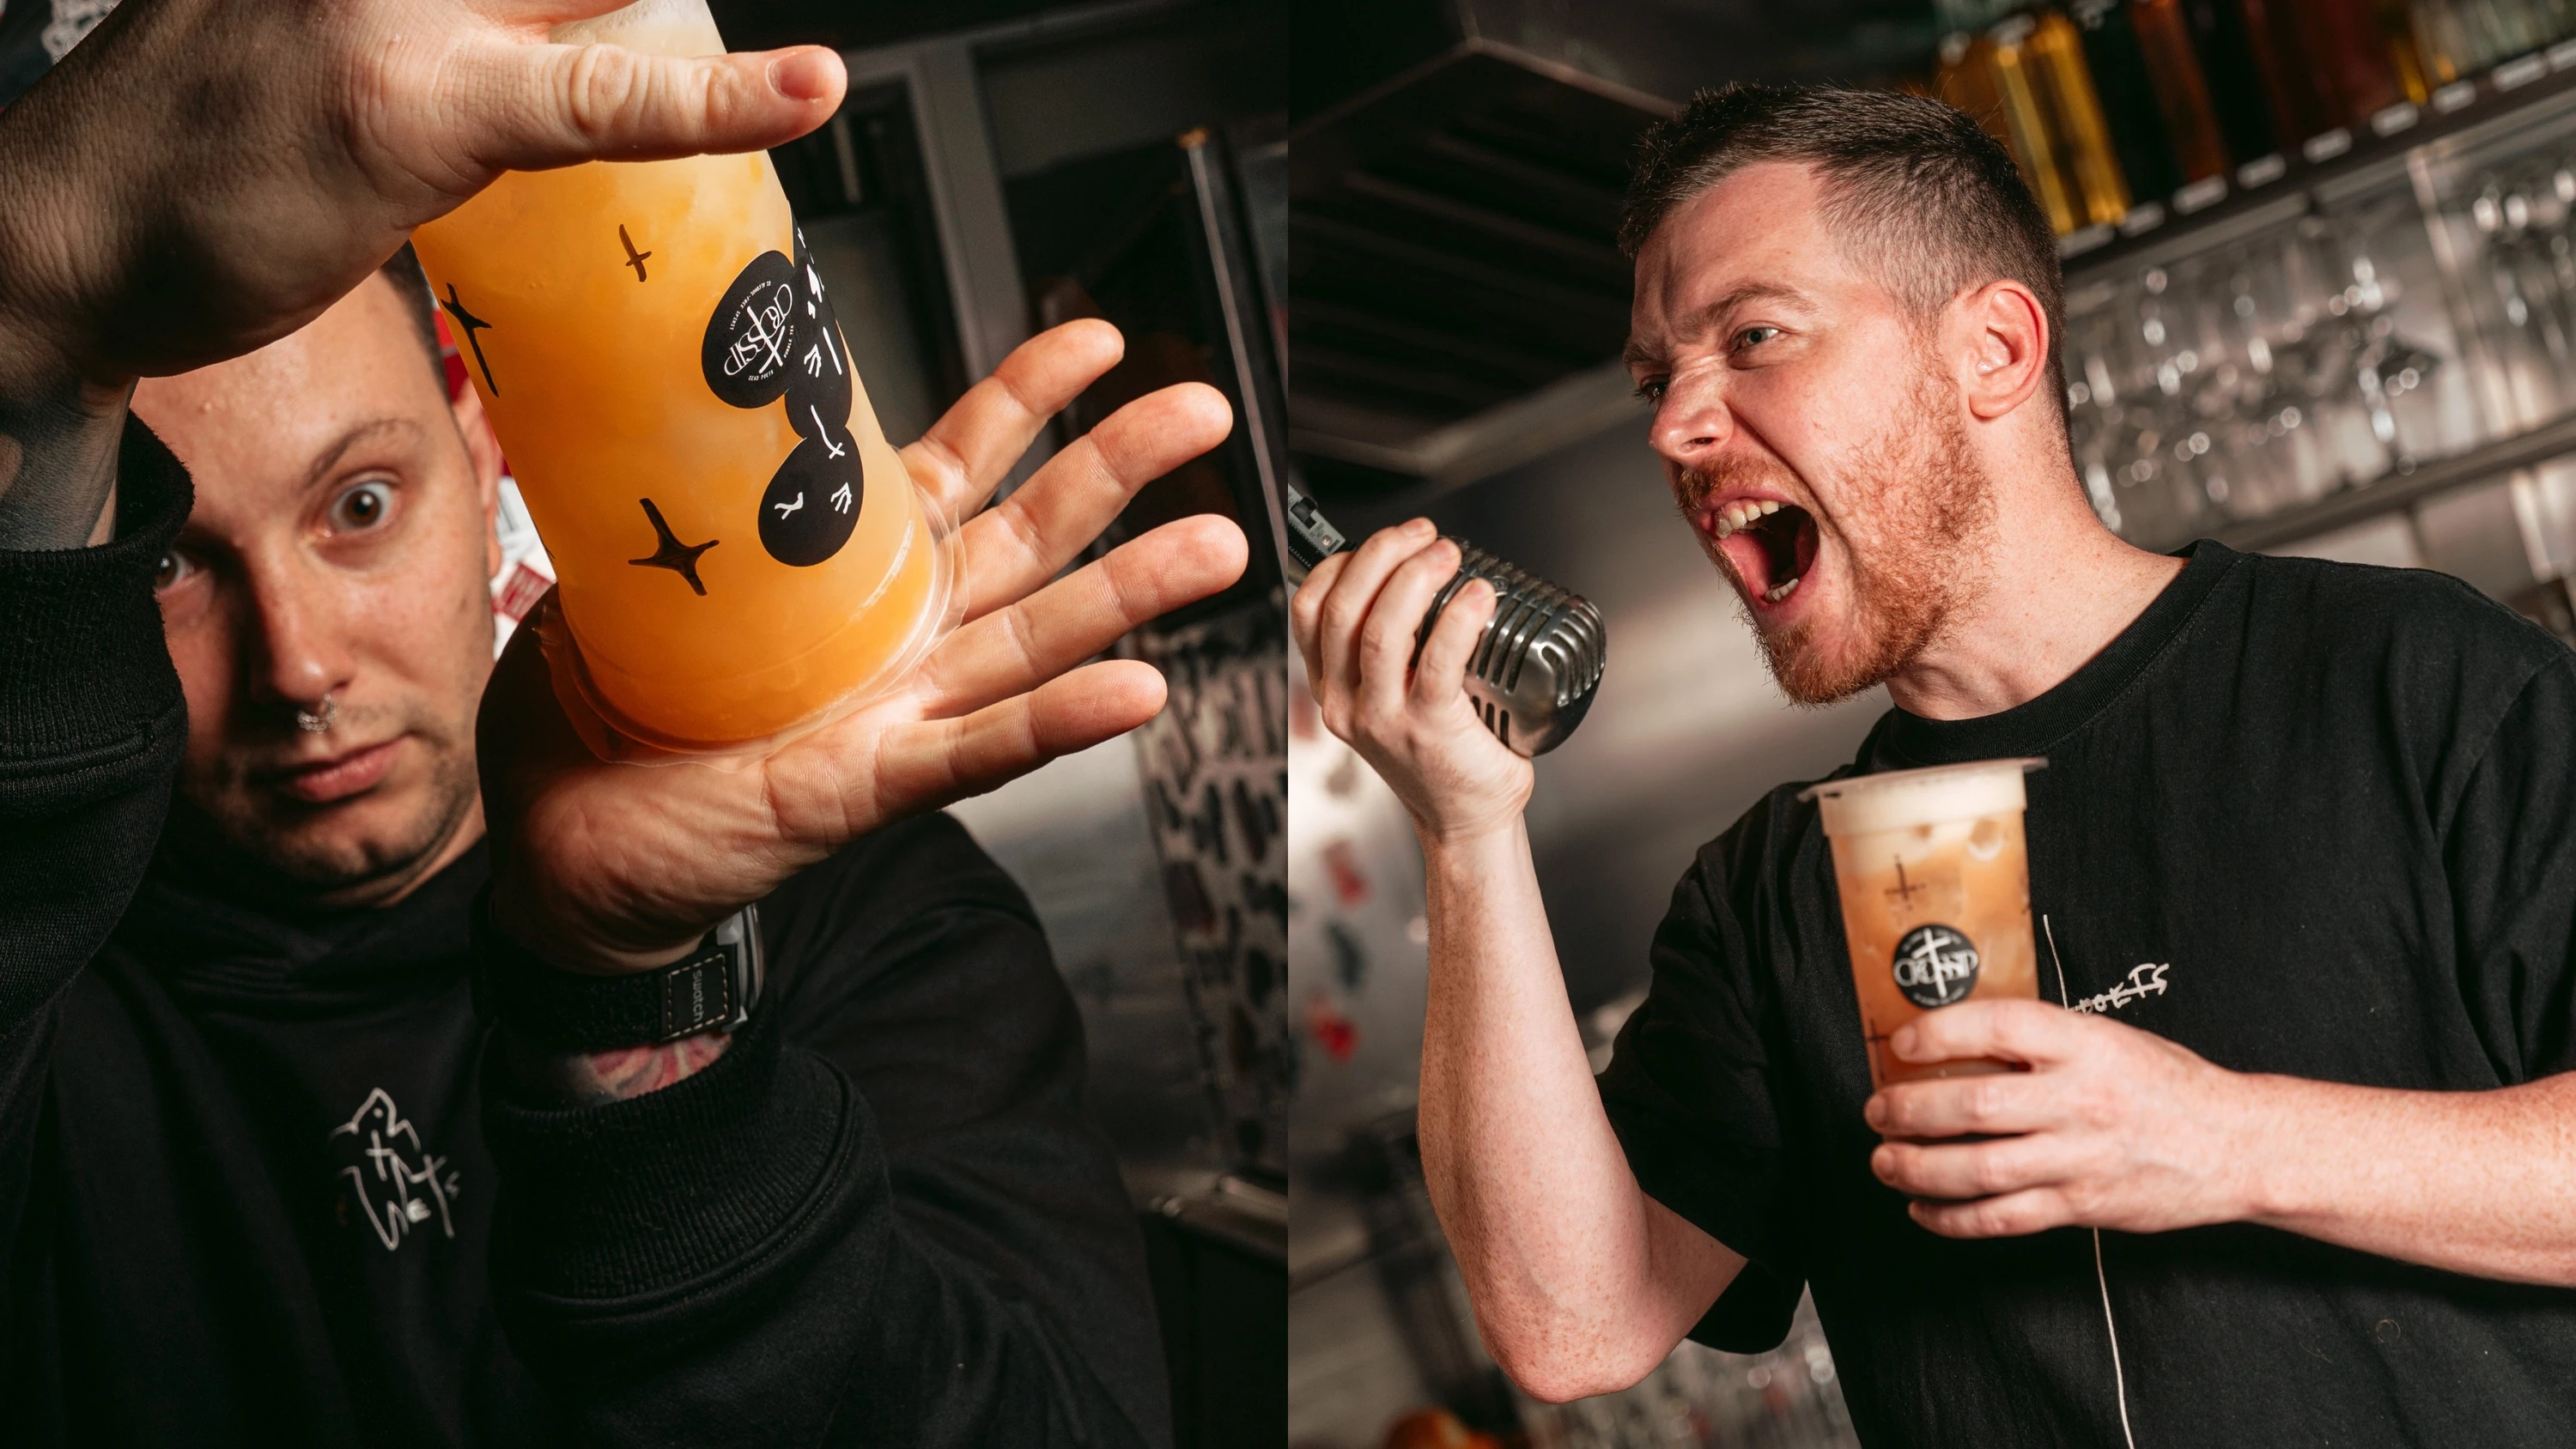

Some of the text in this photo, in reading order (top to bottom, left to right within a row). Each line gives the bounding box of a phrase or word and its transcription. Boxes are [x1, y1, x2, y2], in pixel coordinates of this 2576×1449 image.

[724, 283, 793, 375] CROSSIP
[729, 310, 741, 331] SPIRIT
[783, 338, 793, 359] BUBBLE
[761, 370, 774, 380] POETS
[692, 969, 704, 1022] swatch
